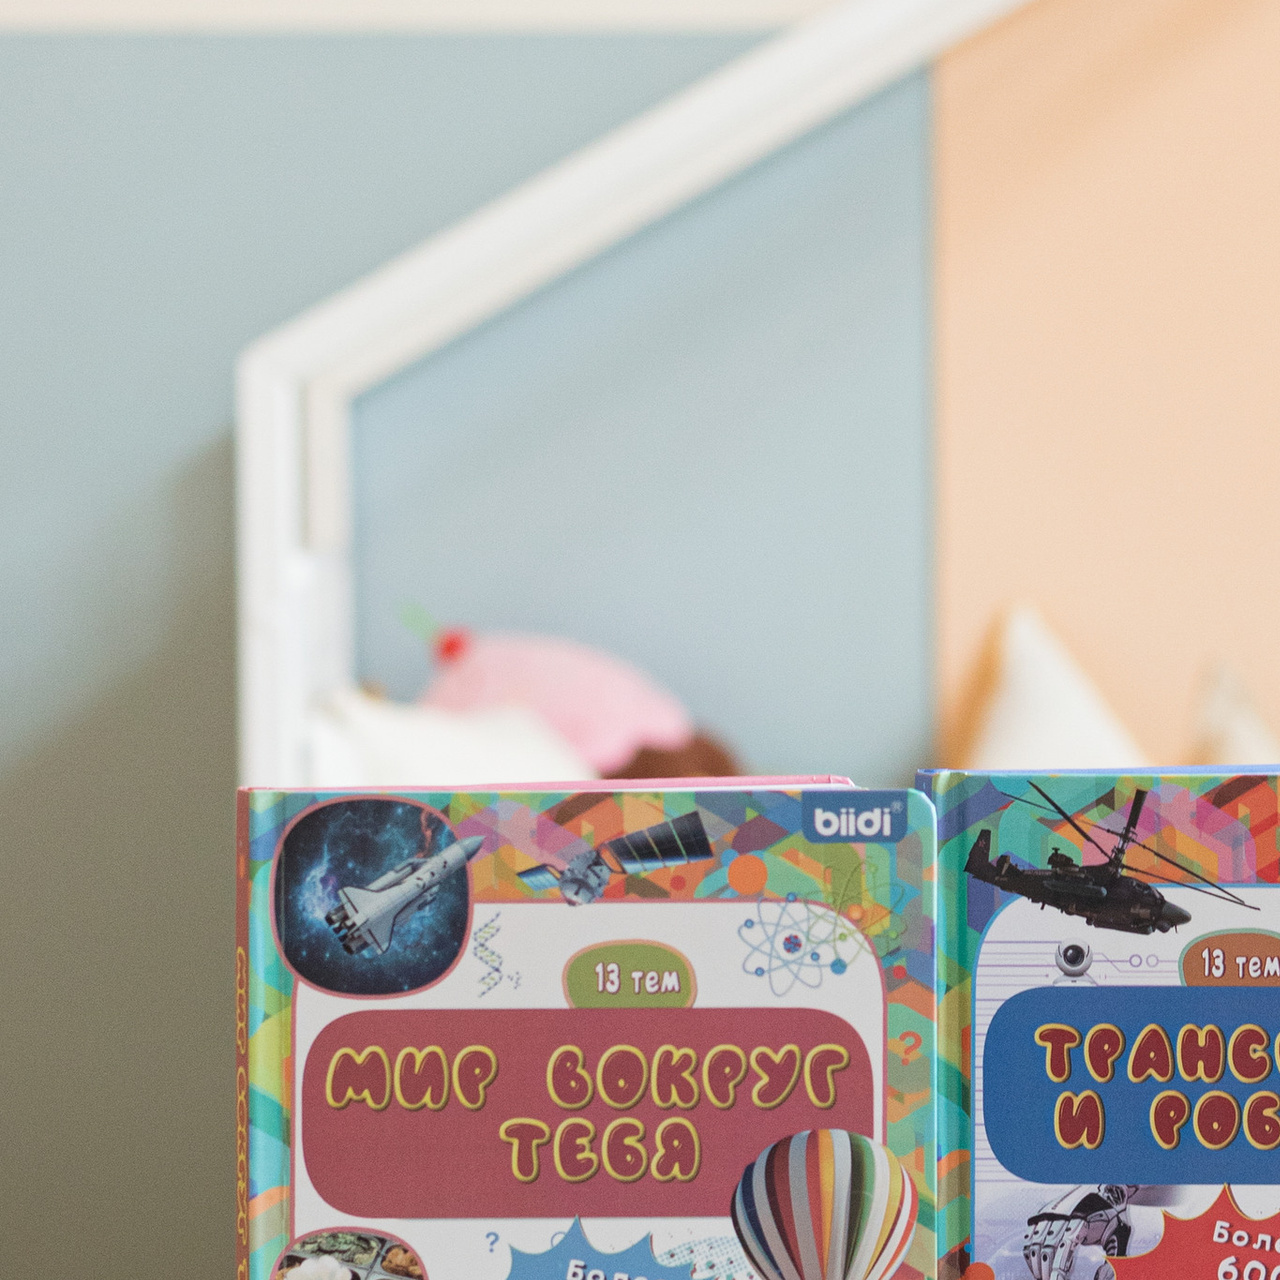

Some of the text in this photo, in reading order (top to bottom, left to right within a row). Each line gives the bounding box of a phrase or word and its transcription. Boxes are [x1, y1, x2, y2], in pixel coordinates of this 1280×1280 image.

[594, 961, 682, 995] 13 тем
[1201, 948, 1225, 978] 13
[325, 1043, 851, 1112] МИР ВОКРУГ
[499, 1116, 702, 1183] ТЕБЯ
[1054, 1089, 1107, 1151] И
